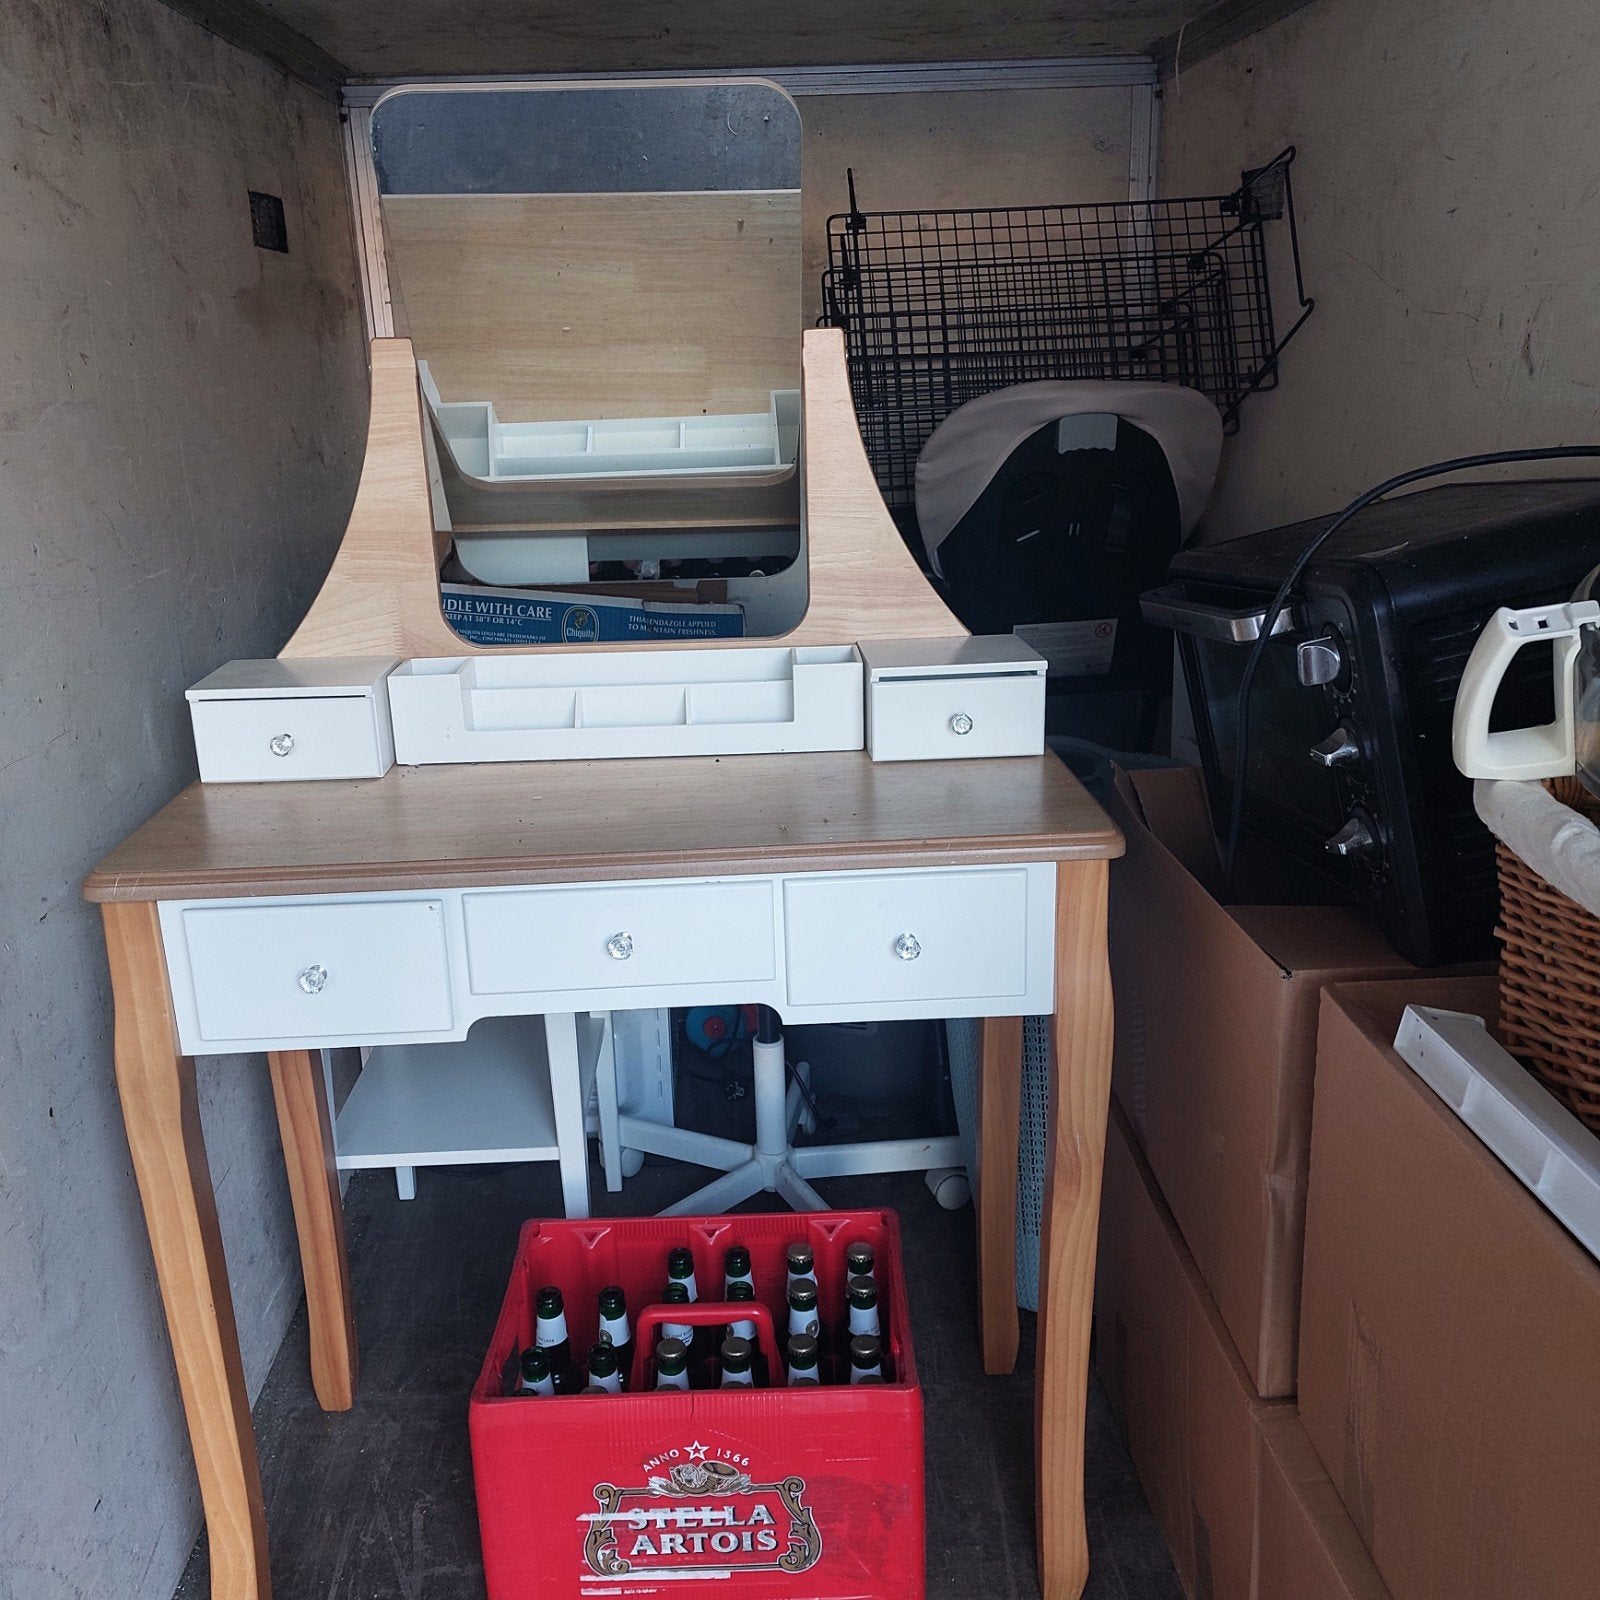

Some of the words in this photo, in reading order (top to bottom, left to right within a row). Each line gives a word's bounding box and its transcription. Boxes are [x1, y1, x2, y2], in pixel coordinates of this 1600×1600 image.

[443, 599, 472, 612] DLE
[475, 601, 513, 615] WITH
[516, 605, 552, 618] CARE
[628, 623, 639, 631] TO
[629, 615, 687, 628] THIAENDAZOLE
[687, 620, 717, 628] APPLIED
[566, 627, 595, 639] Chiquita
[643, 1449, 680, 1473] ANNO
[716, 1448, 750, 1466] 1366
[628, 1504, 775, 1530] STELLA
[629, 1529, 779, 1556] ARTOIS
